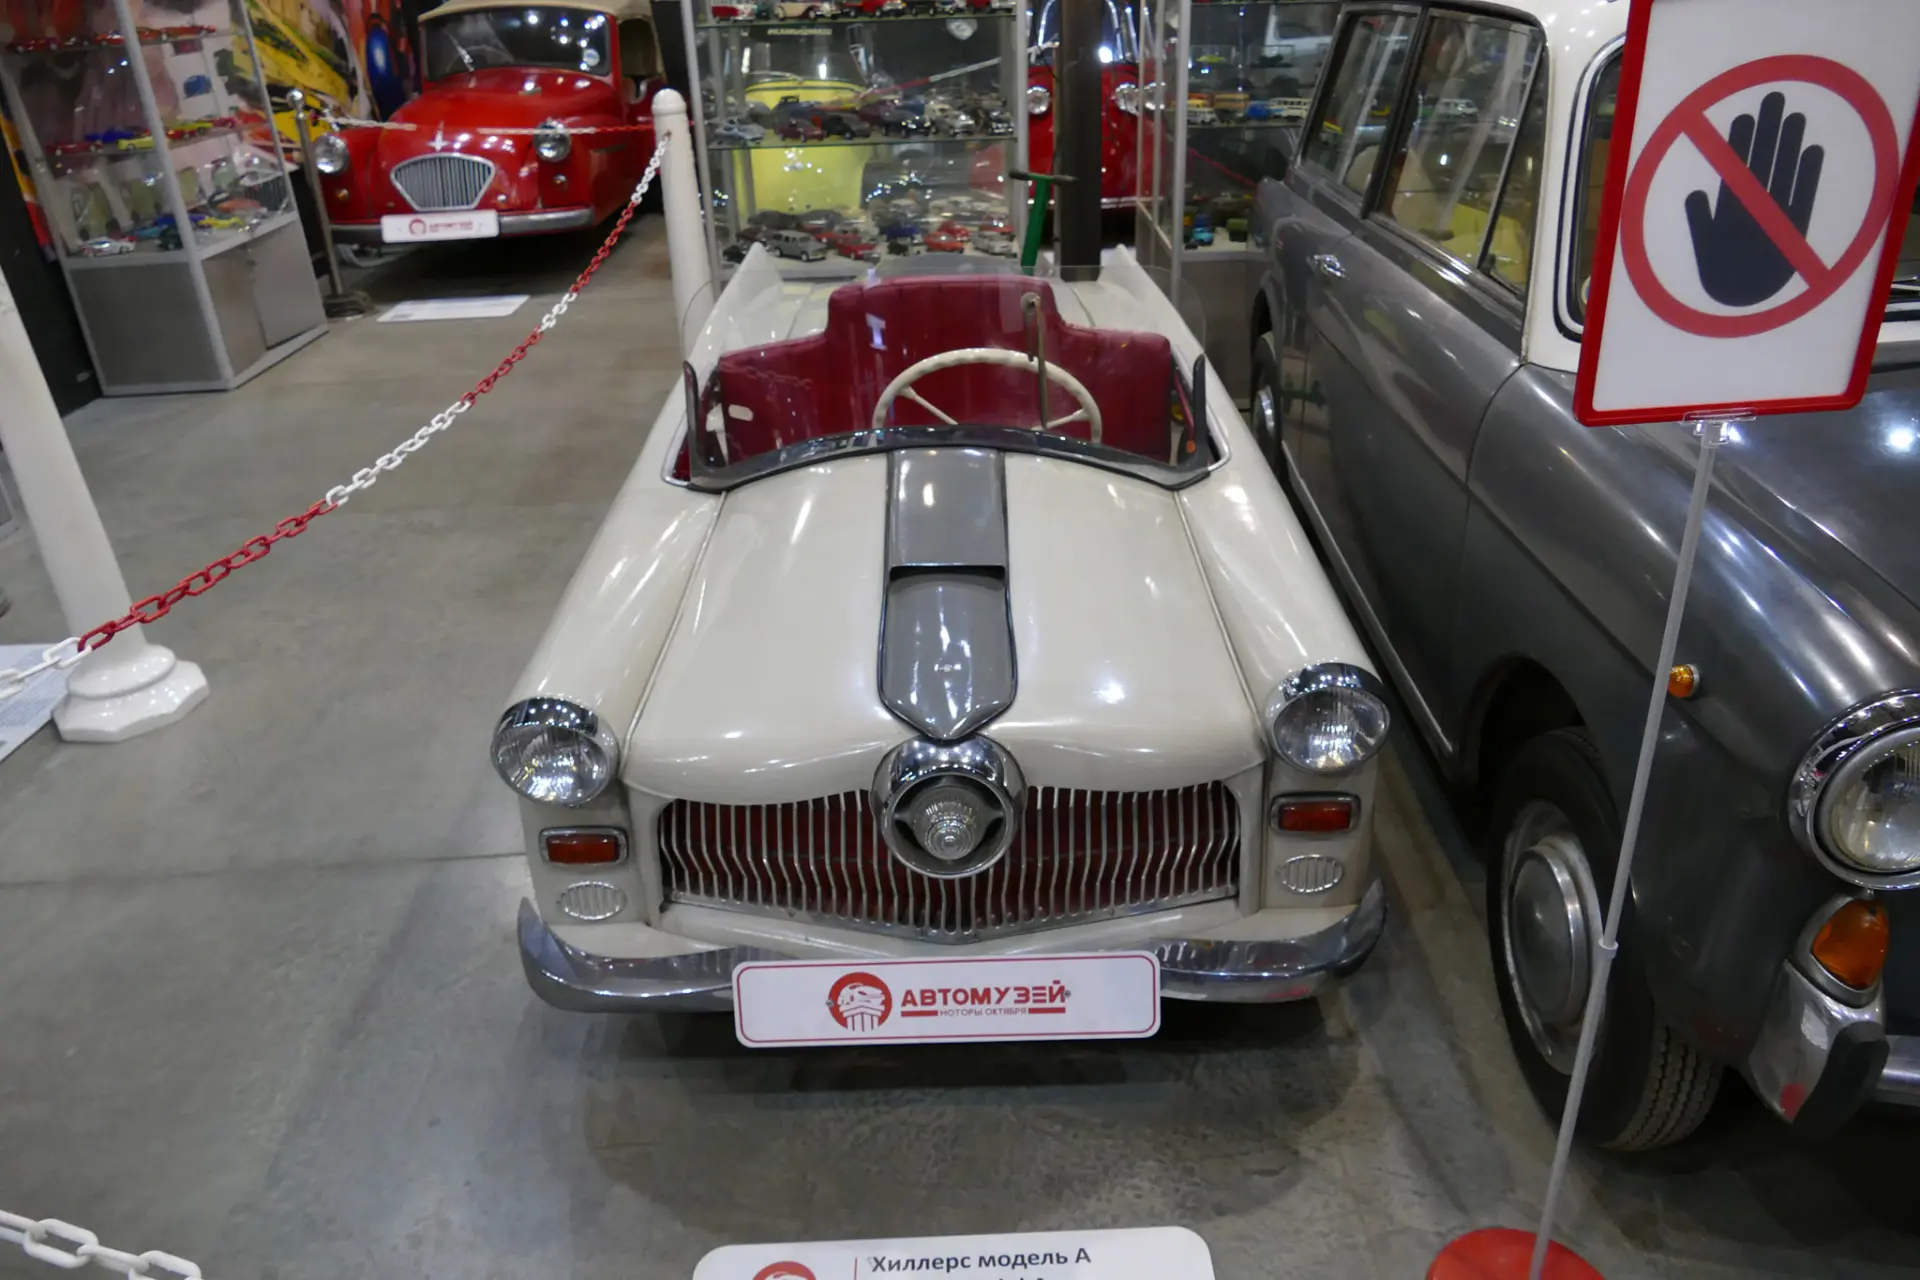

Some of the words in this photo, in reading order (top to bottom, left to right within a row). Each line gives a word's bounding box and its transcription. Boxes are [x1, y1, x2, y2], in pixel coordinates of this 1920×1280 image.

[901, 980, 1066, 1007] АВТОМУЗЕЙ
[985, 1007, 1027, 1016] ОКТЯБРЯ
[872, 1256, 972, 1273] Хиллерс
[978, 1251, 1068, 1269] модель
[1075, 1247, 1091, 1263] А
